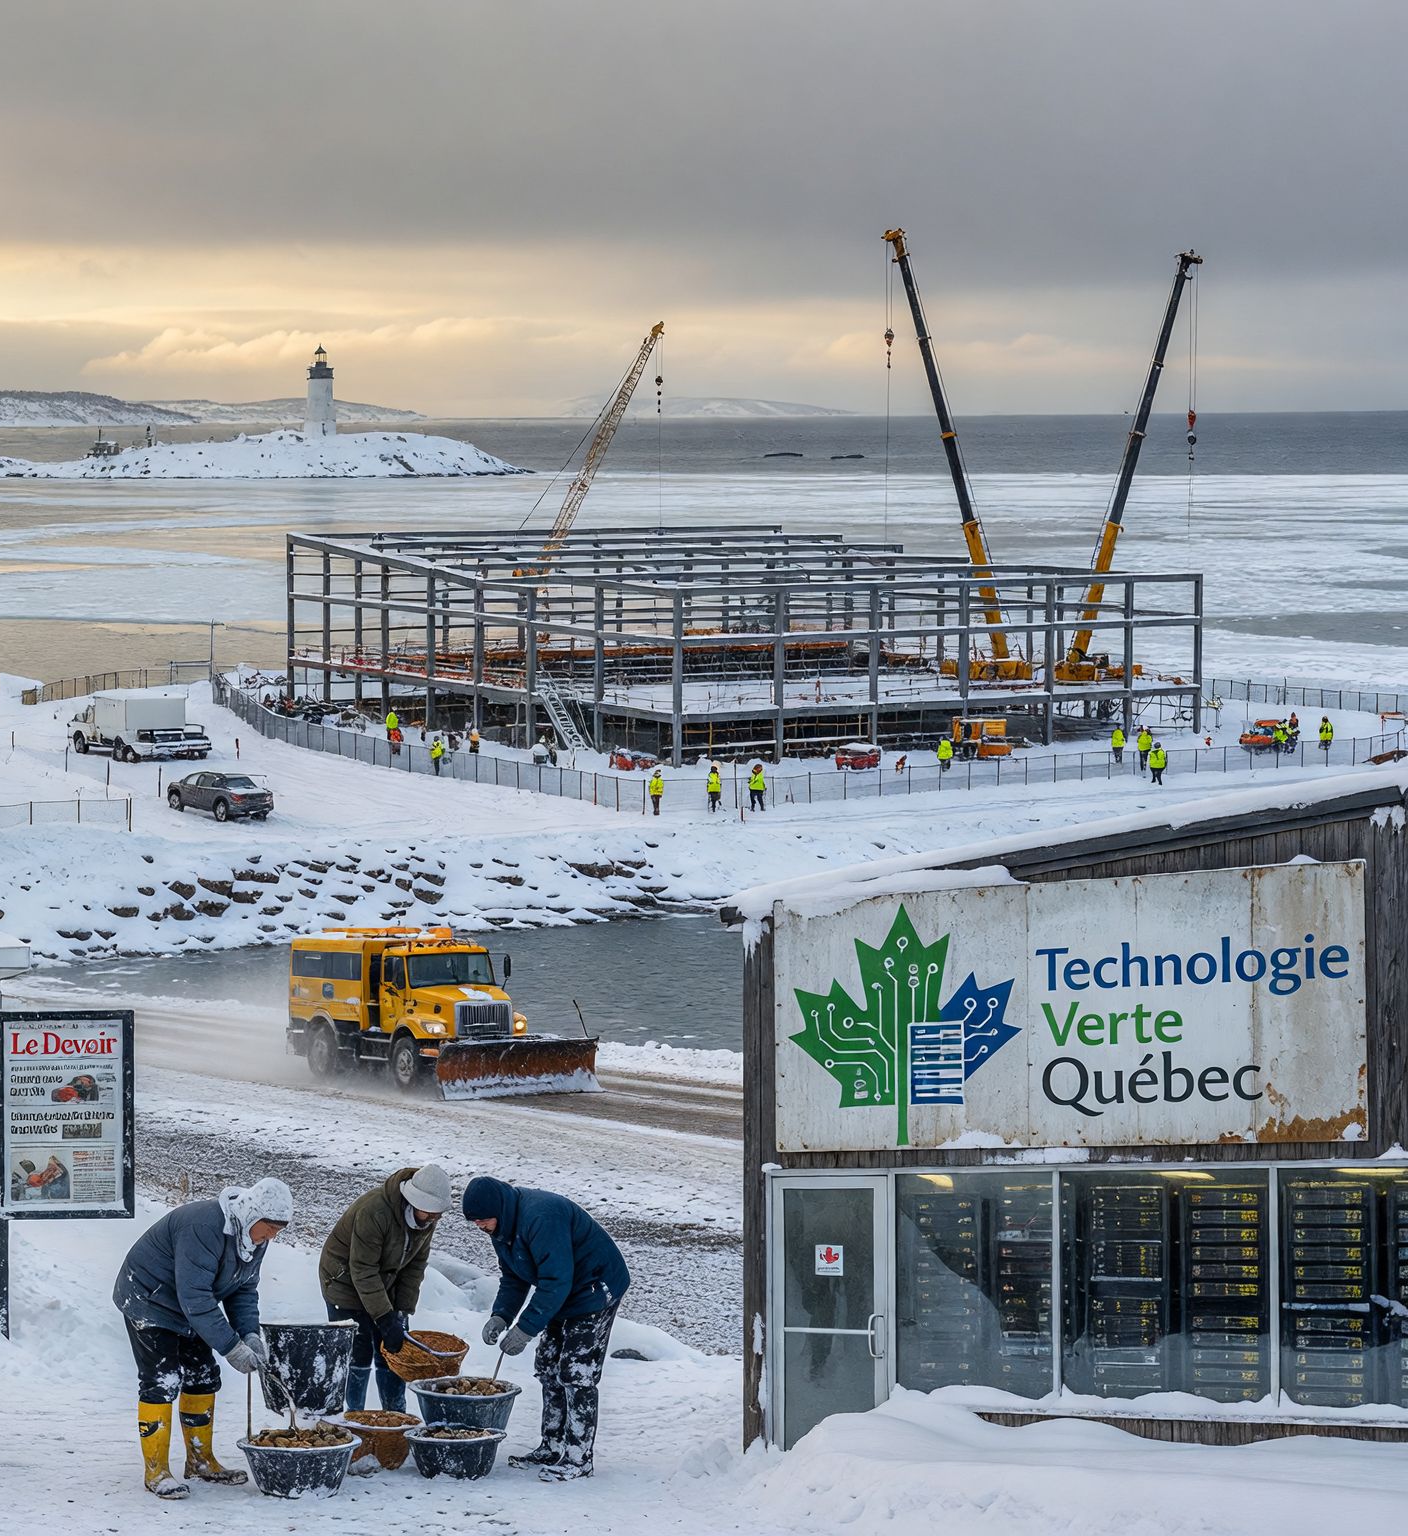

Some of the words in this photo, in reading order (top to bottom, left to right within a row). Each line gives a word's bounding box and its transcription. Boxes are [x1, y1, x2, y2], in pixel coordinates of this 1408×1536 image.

[1035, 933, 1351, 997] Technologie
[10, 1032, 39, 1055] Le
[41, 1031, 118, 1055] Devoir
[1041, 1001, 1184, 1047] Verte
[1041, 1050, 1264, 1116] Québec
